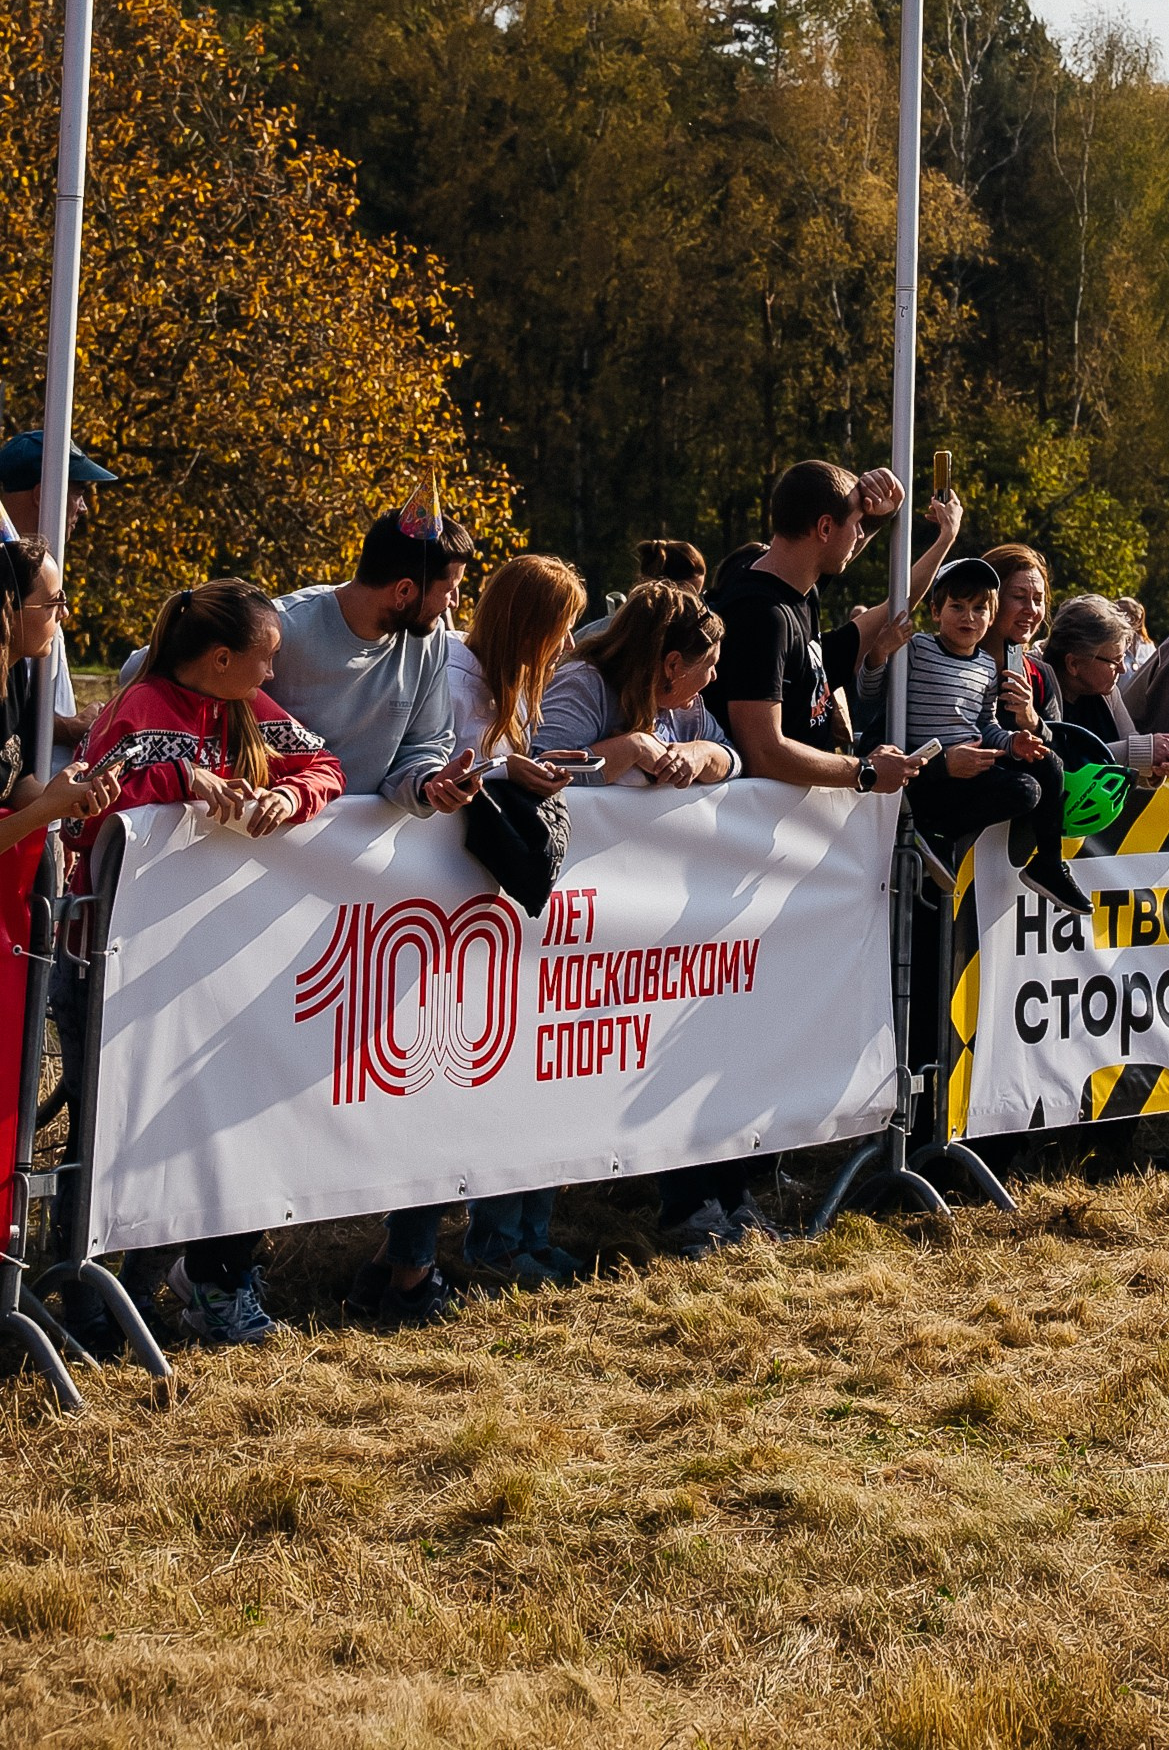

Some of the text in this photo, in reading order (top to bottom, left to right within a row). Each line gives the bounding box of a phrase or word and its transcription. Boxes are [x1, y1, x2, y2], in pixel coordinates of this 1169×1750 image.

[541, 888, 598, 947] ЛЕТ
[1015, 894, 1085, 956] на
[294, 892, 522, 1106] 100
[537, 939, 760, 1014] МОСКОВСКОМУ
[536, 1014, 651, 1082] СПОРТУ
